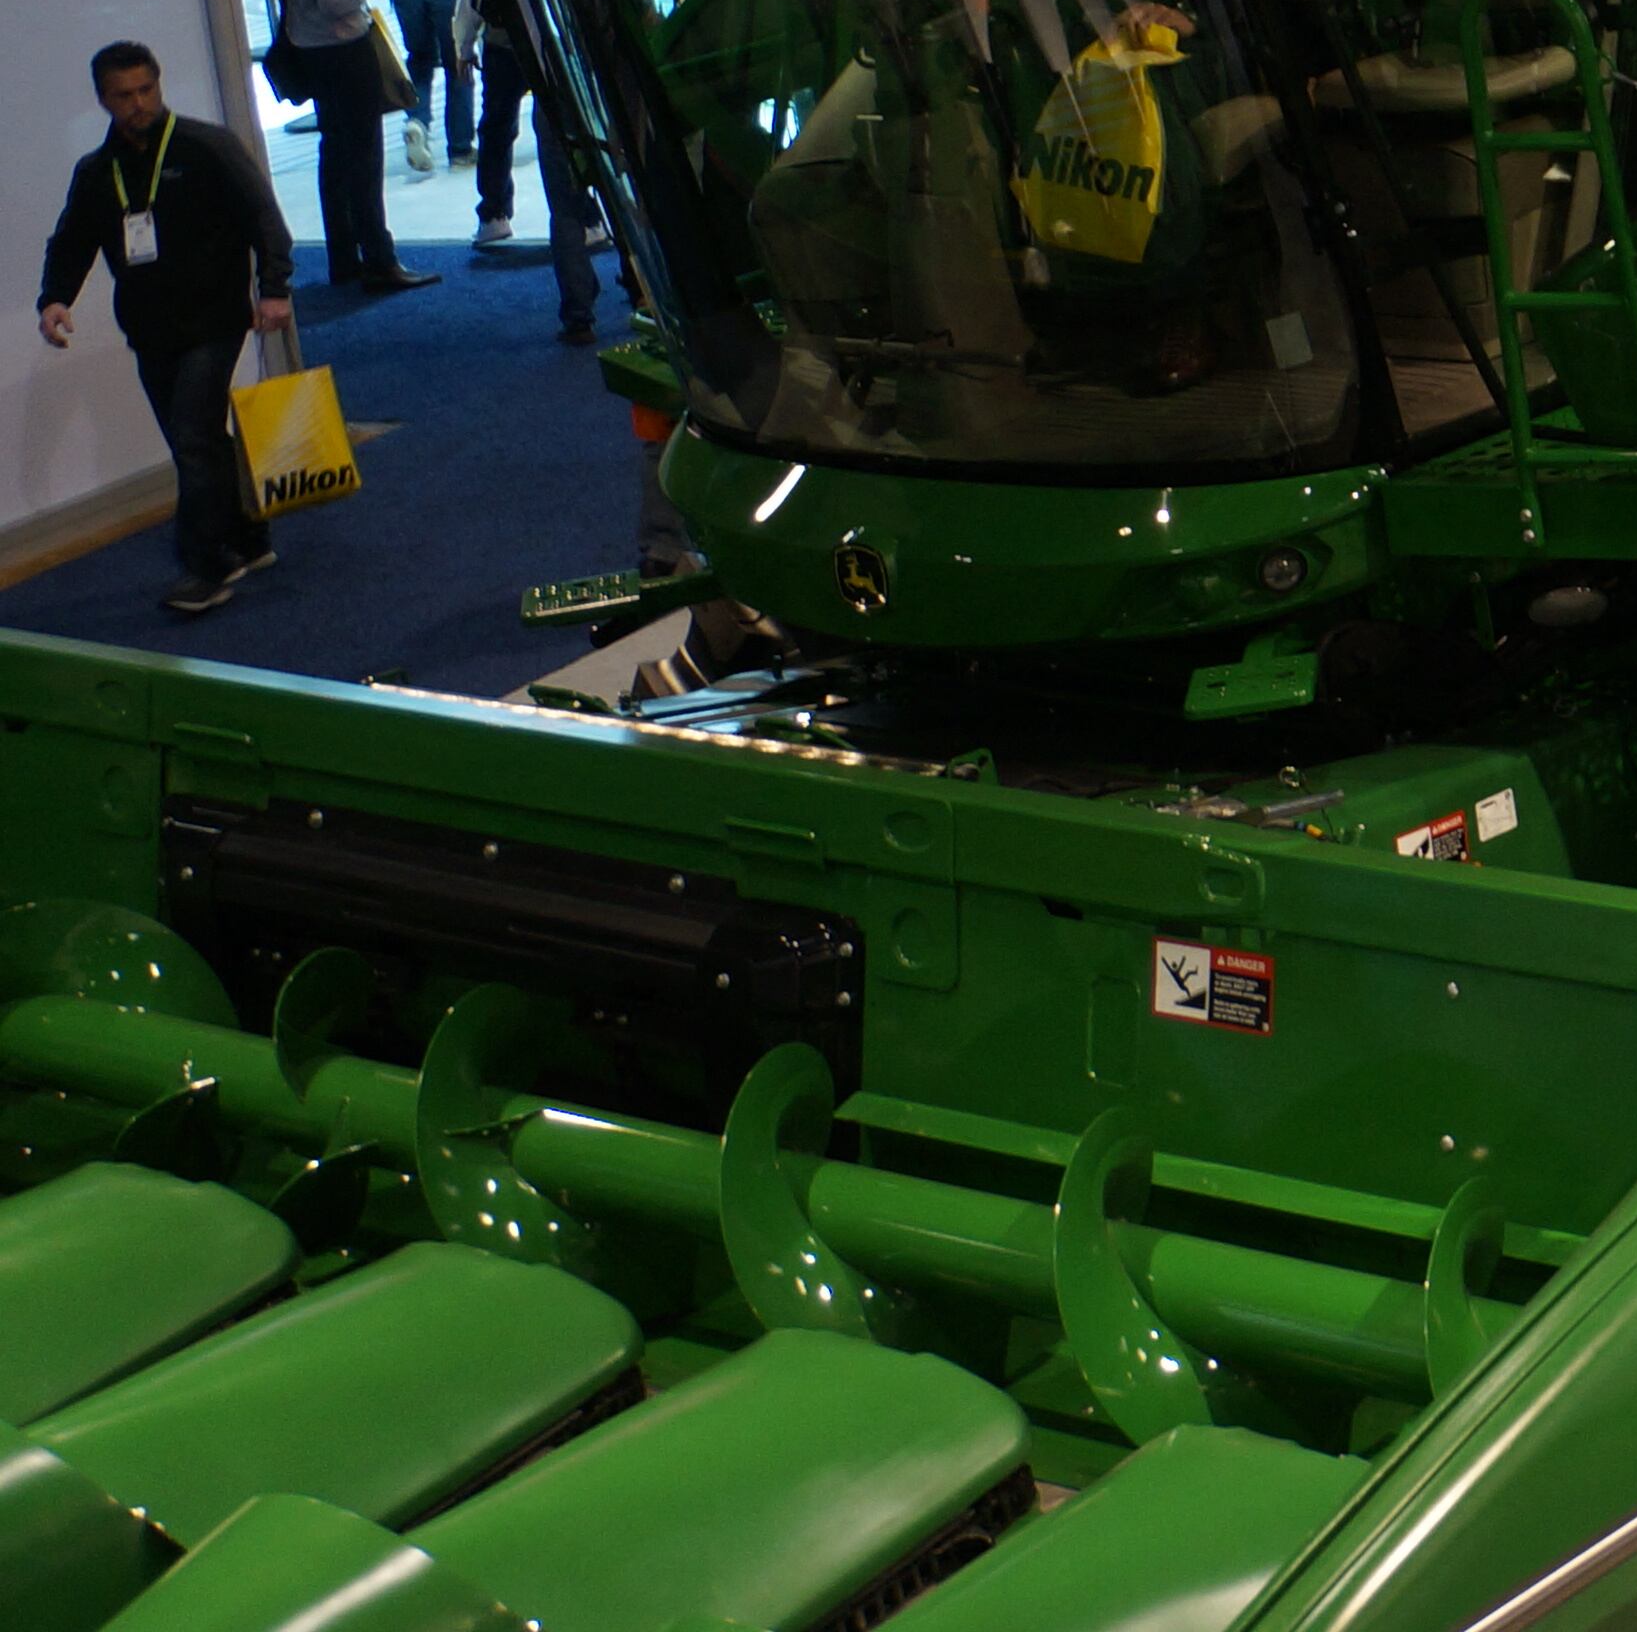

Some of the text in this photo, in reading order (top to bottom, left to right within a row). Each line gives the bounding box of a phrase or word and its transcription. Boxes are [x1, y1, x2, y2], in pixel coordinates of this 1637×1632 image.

[1018, 135, 1155, 203] Nikon
[264, 464, 355, 506] Nikon
[1226, 956, 1267, 974] DANGER
